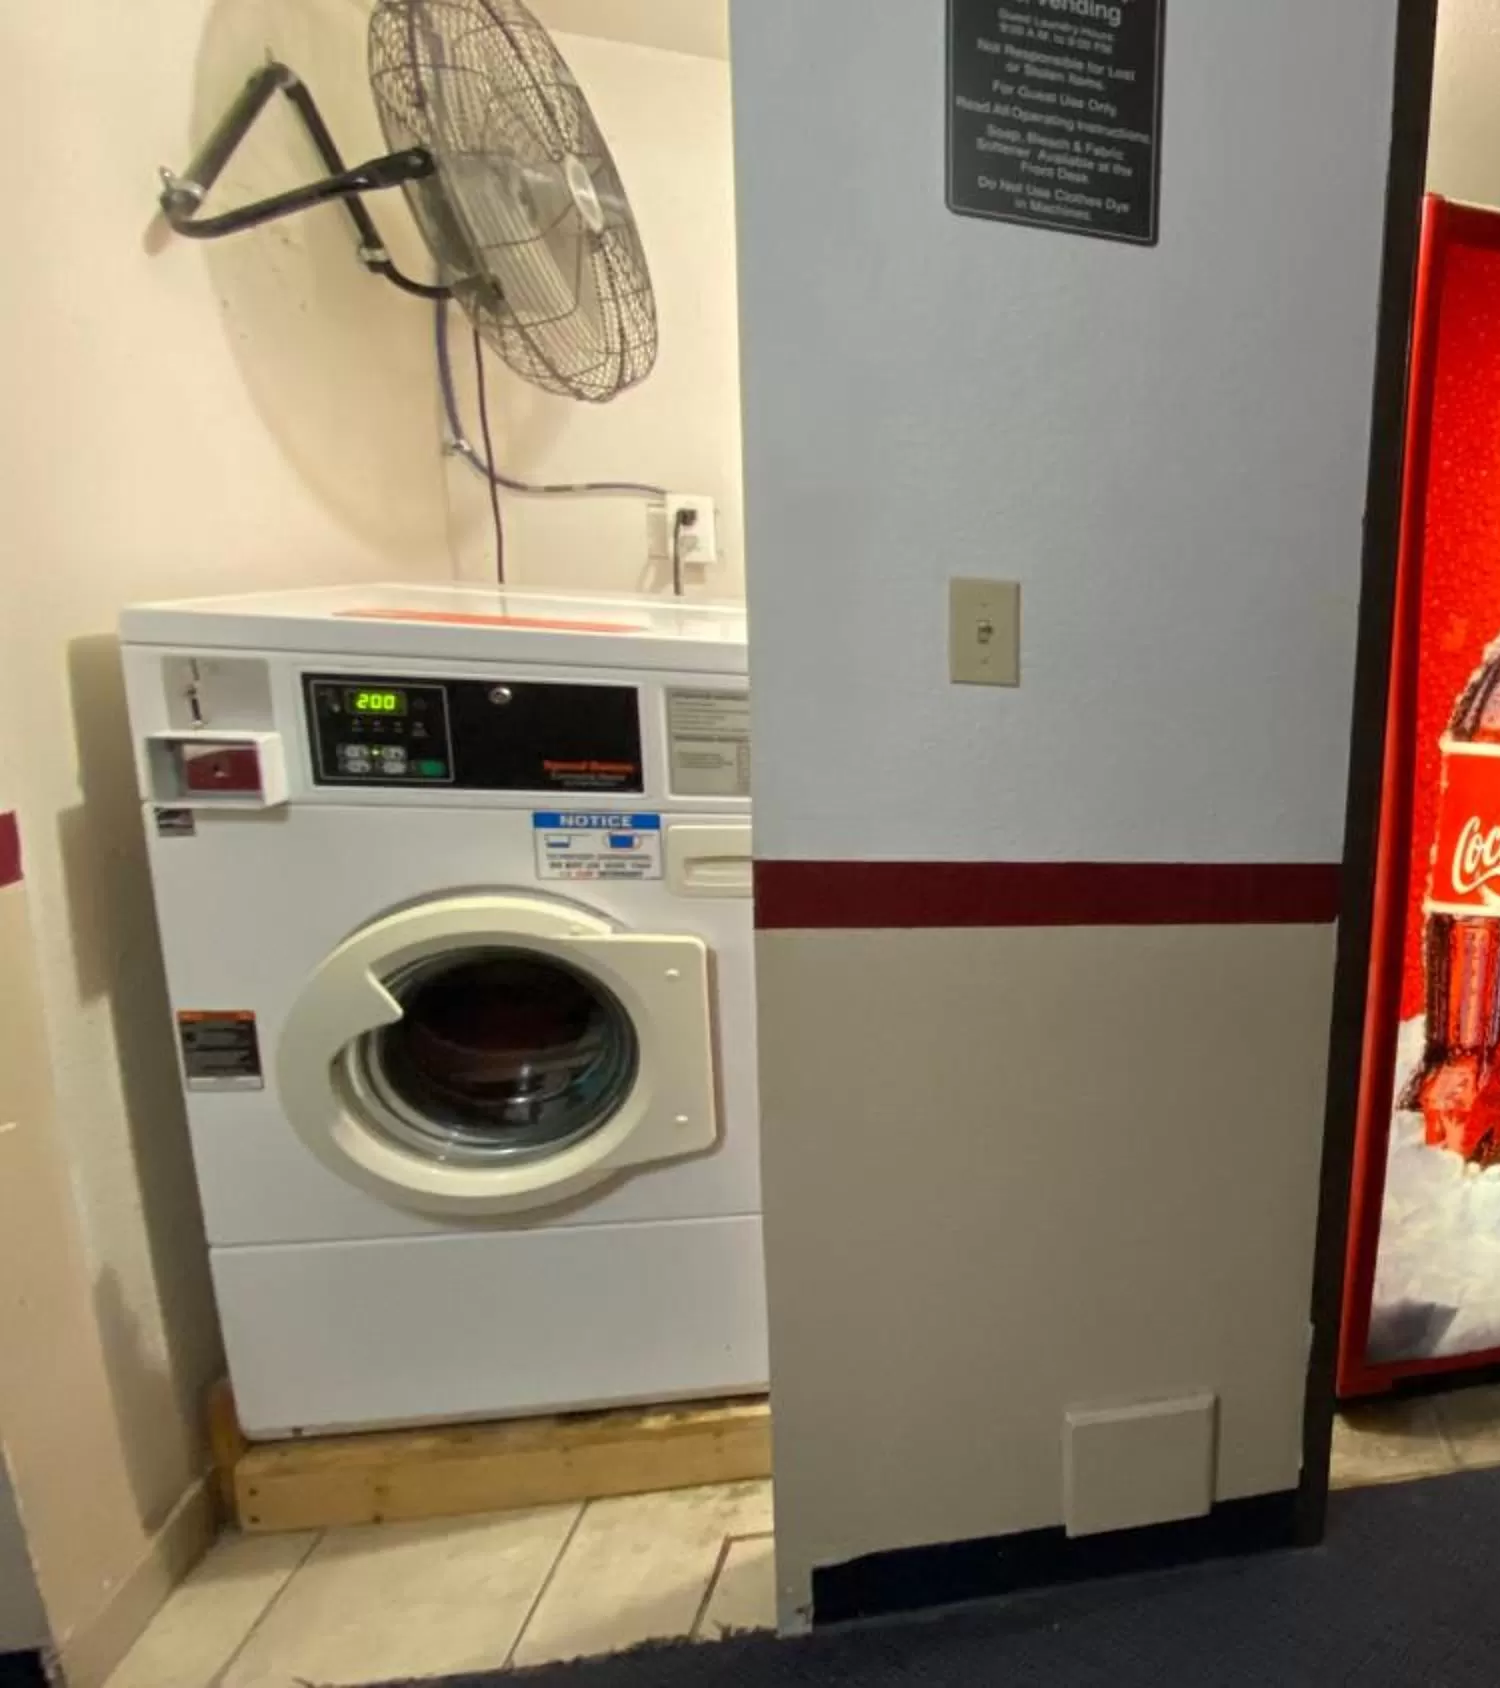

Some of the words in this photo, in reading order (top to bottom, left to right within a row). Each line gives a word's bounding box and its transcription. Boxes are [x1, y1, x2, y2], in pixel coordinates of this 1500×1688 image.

[977, 37, 1001, 53] Not
[1004, 44, 1084, 72] Responsible
[1087, 61, 1104, 75] for
[1005, 62, 1020, 73] or
[992, 79, 1014, 94] For
[1017, 85, 1057, 103] Guest
[1060, 94, 1084, 109] Use
[1012, 107, 1075, 132] Operating
[978, 175, 997, 190] Do
[1000, 179, 1023, 193] Not
[1025, 184, 1051, 198] Use
[1054, 188, 1102, 208] Clothes
[1105, 197, 1130, 214] Dye
[559, 815, 633, 828] NOTICE
